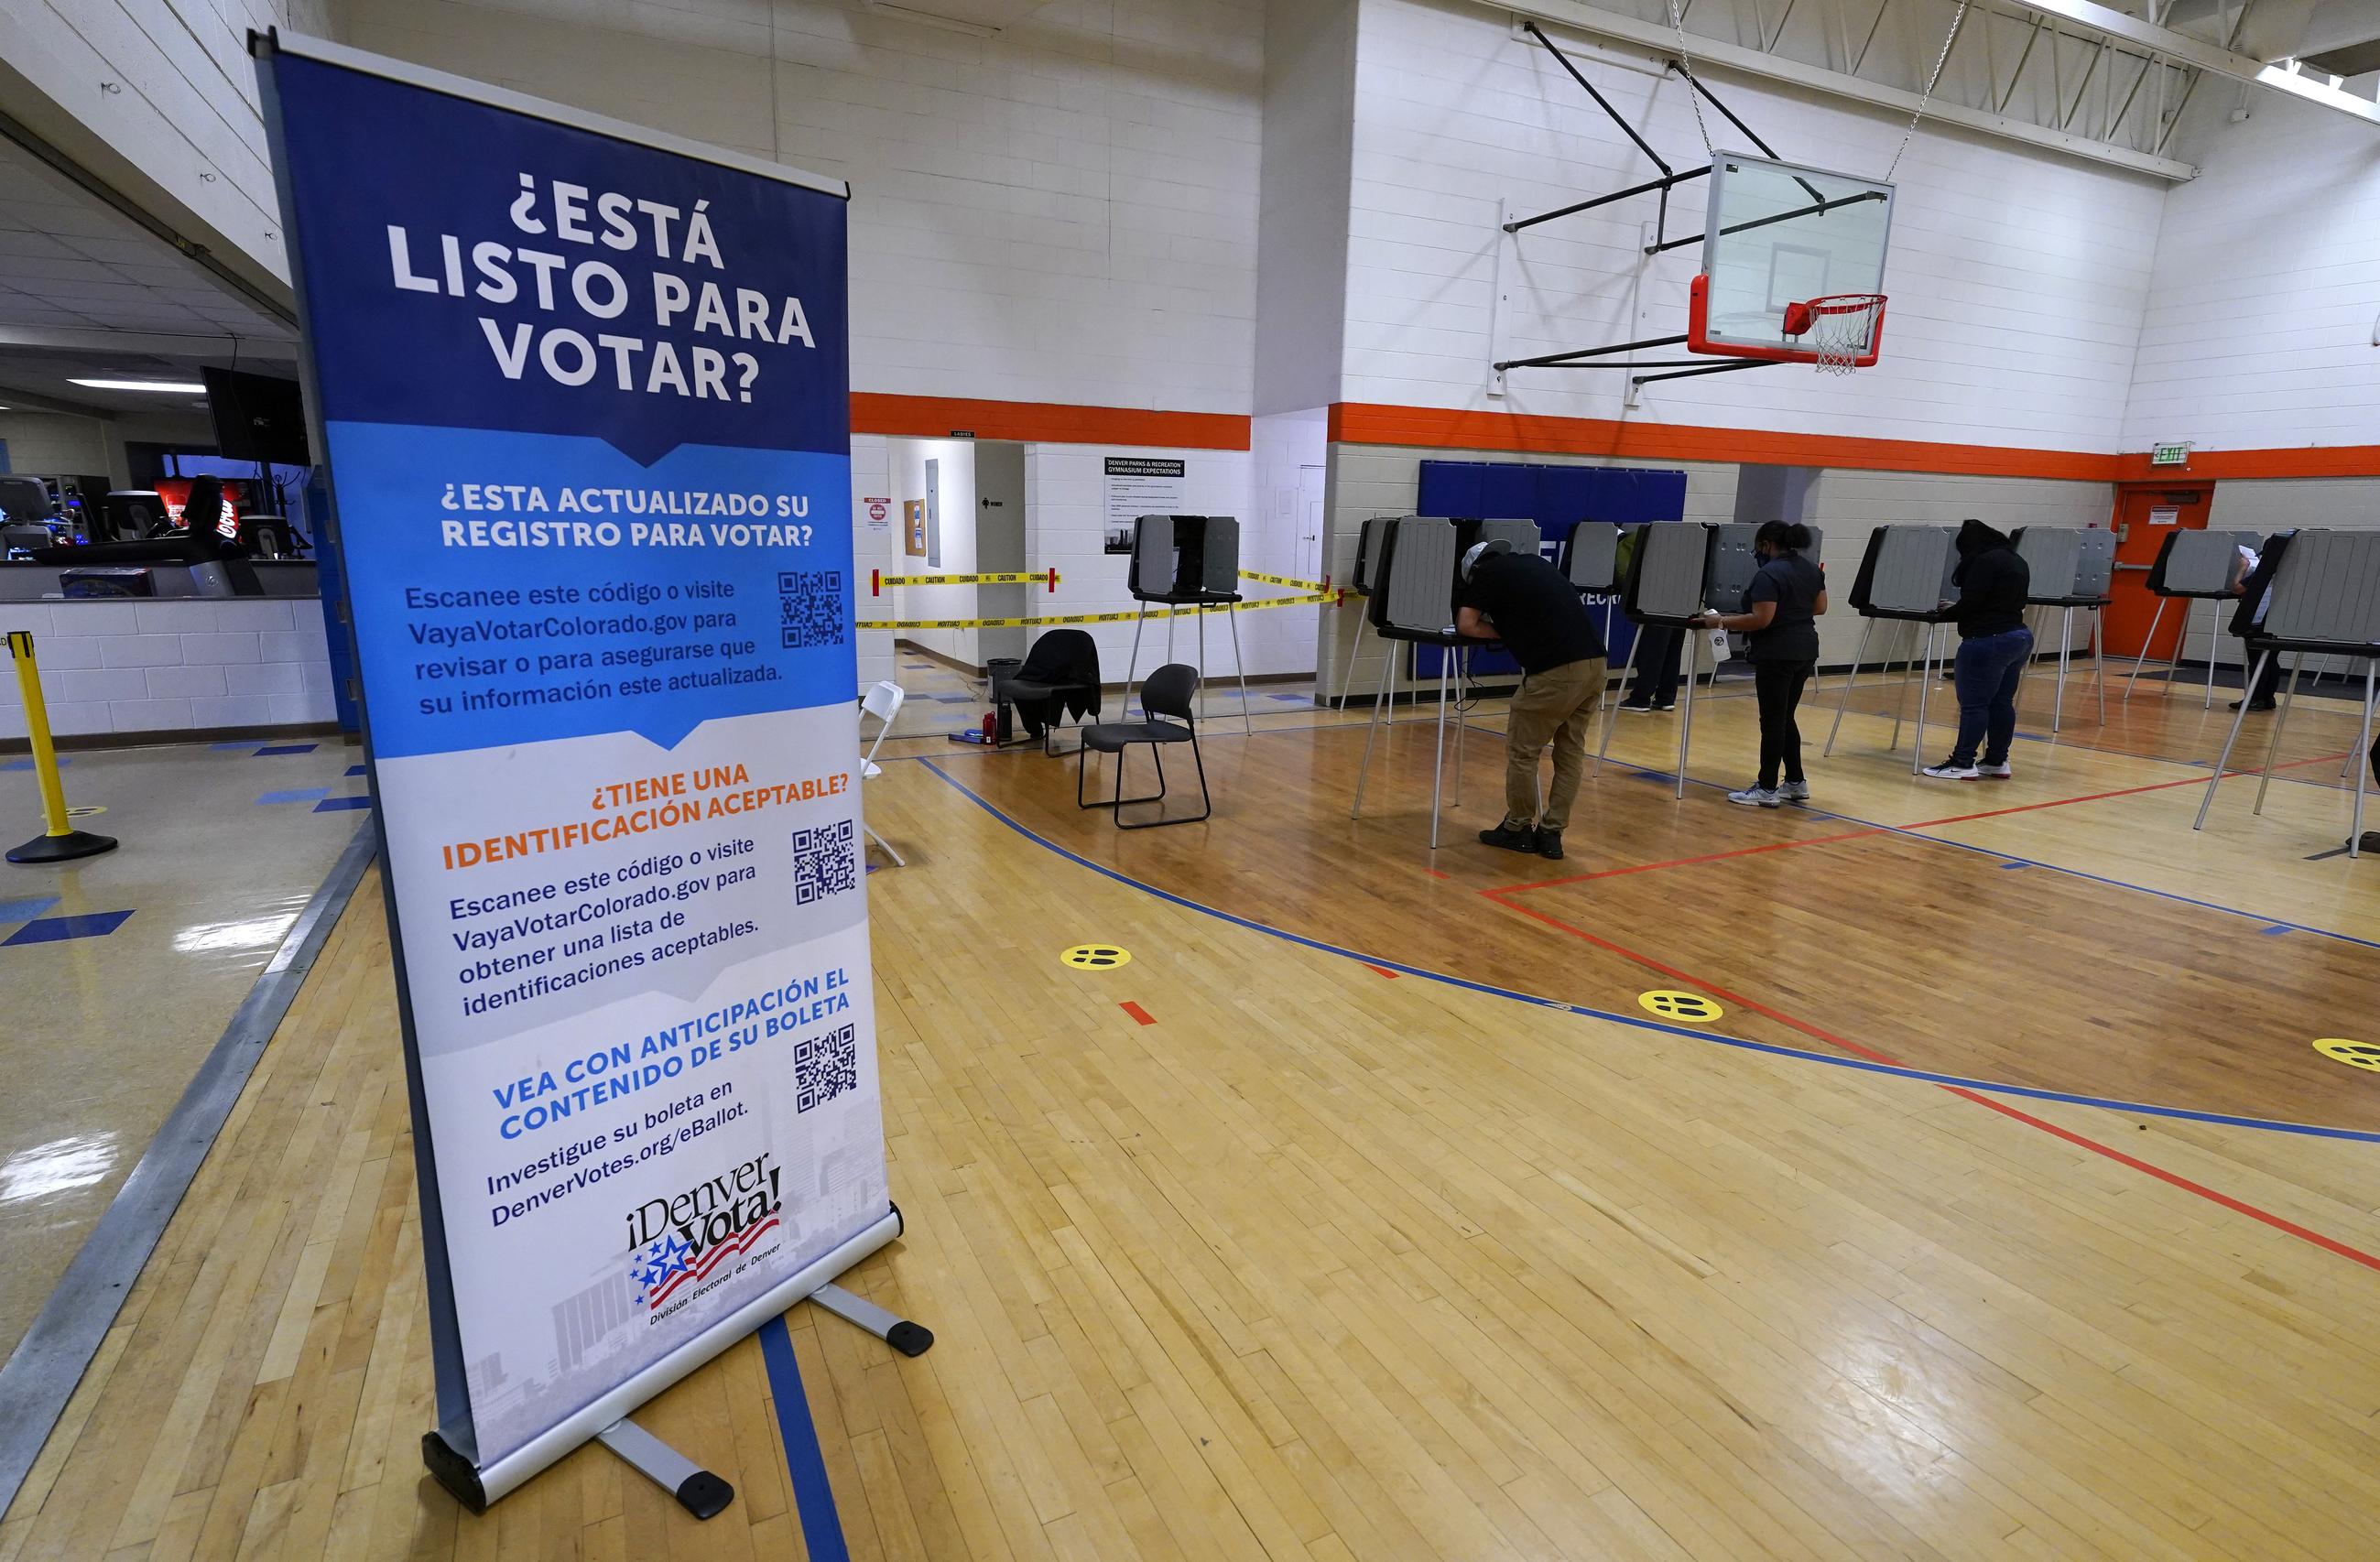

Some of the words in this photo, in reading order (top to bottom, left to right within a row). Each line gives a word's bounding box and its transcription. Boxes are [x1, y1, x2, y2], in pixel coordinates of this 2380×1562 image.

[510, 173, 724, 269] ¿ESTÁ
[387, 225, 627, 319] LISTO
[653, 272, 815, 348] PARA
[478, 318, 758, 403] VOTAR?
[2158, 447, 2183, 461] EXIT
[441, 483, 549, 512] ¿ESTA
[558, 488, 768, 515] ACTUALIZADO
[777, 495, 808, 517] SU
[441, 521, 621, 547] REGISTRO
[631, 523, 705, 546] PARA
[711, 525, 812, 546] VOTAR?
[406, 588, 520, 609] Escanee
[528, 586, 580, 604] este
[589, 582, 660, 605] código
[668, 586, 679, 599] o
[685, 580, 734, 598] visite
[408, 614, 687, 647] VayaVotarColorado.gov
[694, 613, 736, 633] para
[416, 656, 506, 679] revisar
[516, 657, 529, 672] o
[538, 648, 594, 677] para
[601, 641, 715, 669] asegurarse
[721, 637, 755, 660] que
[420, 698, 452, 714] su
[462, 679, 611, 710] información
[619, 677, 661, 696] este
[668, 665, 781, 690] actualizada.
[443, 800, 701, 873] IDENTIFICACIÓN
[708, 774, 848, 819] ACEPTABLE?
[592, 774, 686, 809] ¿TIENE
[694, 764, 748, 790] UNA
[451, 885, 556, 919] Escanee
[565, 873, 610, 894] este
[617, 855, 682, 882] código
[690, 852, 701, 864] o
[707, 840, 754, 861] visite
[451, 873, 709, 954] VayaVotarColorado.gov
[717, 867, 755, 891] para
[460, 947, 555, 983] obtener
[564, 935, 603, 957] una
[612, 921, 653, 943] lista
[660, 911, 684, 929] de
[460, 950, 645, 1015] identificaciones
[652, 921, 757, 960] aceptables.
[493, 1072, 557, 1109] VEA
[566, 1043, 630, 1082] CON
[641, 977, 822, 1060] ANTICIPACIÓN
[827, 969, 848, 990] EL
[501, 1053, 685, 1142] CONTENIDO
[690, 1044, 723, 1069] DE
[729, 1025, 757, 1051] SU
[766, 993, 850, 1040] BOLETA
[488, 1135, 605, 1199] Investigue
[613, 1117, 639, 1144] su
[645, 1094, 703, 1130] boleta
[711, 1082, 732, 1100] en
[488, 1102, 747, 1227] DenverVotes.org/eBallot.
[625, 1152, 769, 1252] ¡Denver
[678, 1166, 781, 1258] Vota!
[650, 1297, 688, 1326] División
[692, 1268, 732, 1300] Electoral
[735, 1263, 746, 1275] de
[751, 1242, 780, 1266] Denver
